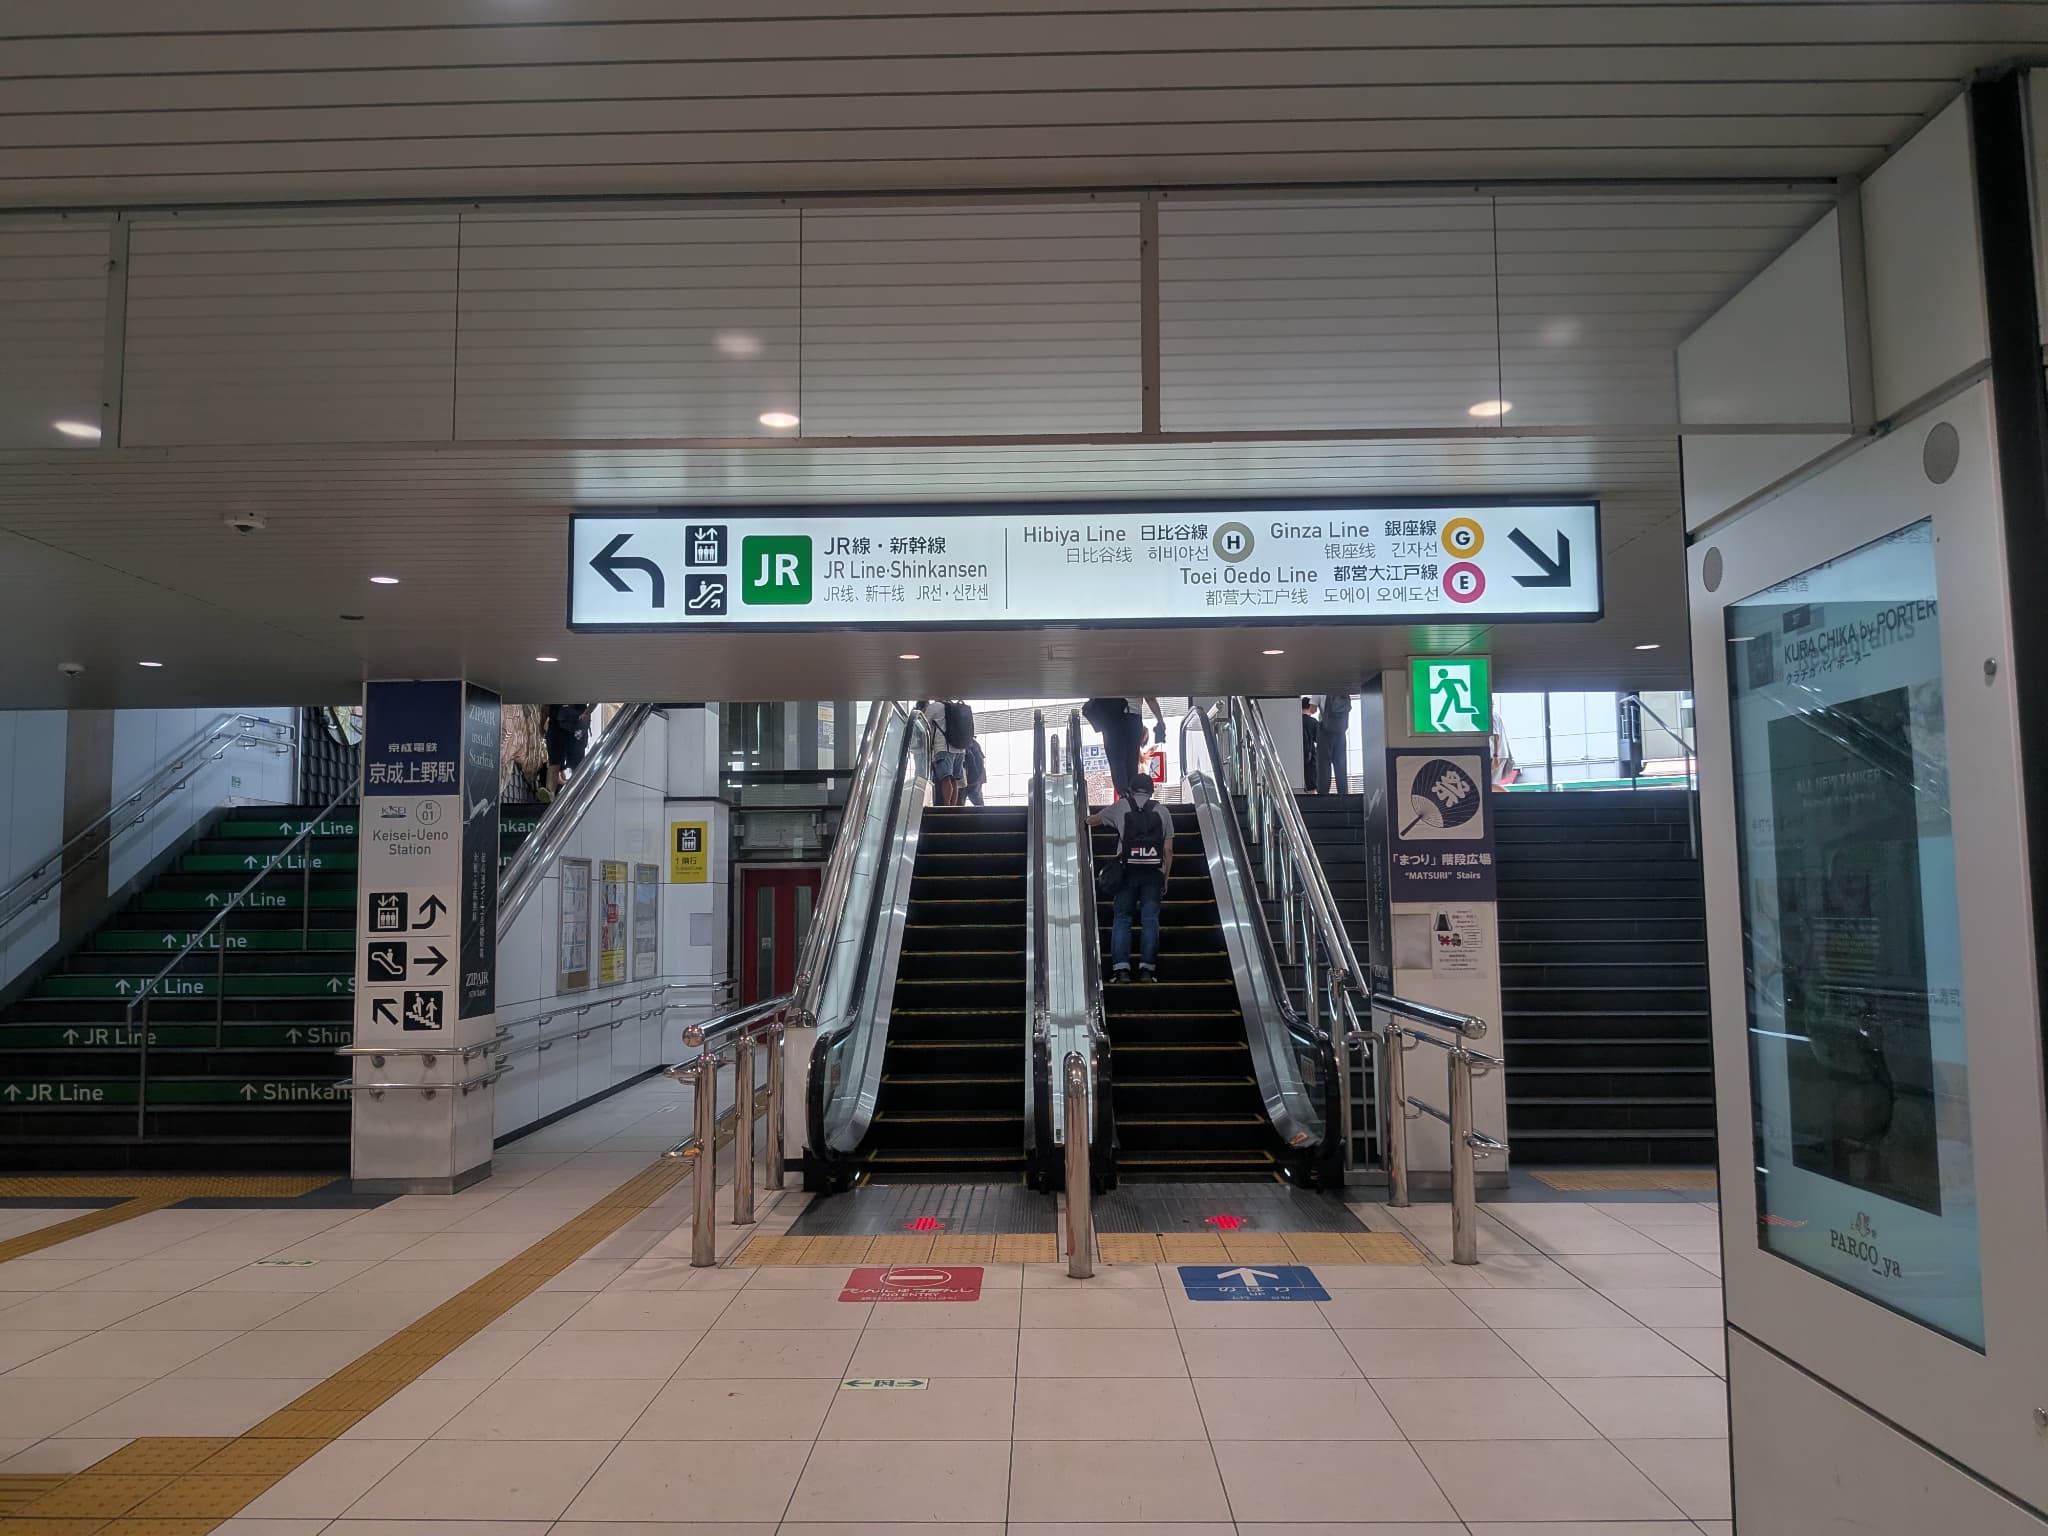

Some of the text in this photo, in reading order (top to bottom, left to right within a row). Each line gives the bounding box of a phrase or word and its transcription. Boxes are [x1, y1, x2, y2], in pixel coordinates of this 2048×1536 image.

[1024, 524, 1126, 546] Hibiya Line
[1140, 524, 1208, 541] 日比谷線
[1271, 521, 1369, 539] Ginza Line
[1384, 519, 1437, 537] 銀座線
[824, 535, 946, 555] JR線・新幹線
[1226, 535, 1240, 549] H
[1455, 530, 1470, 545] G
[1066, 547, 1132, 564] 日比谷线
[1147, 545, 1209, 562] 히비야선
[1324, 542, 1376, 559] 银座线
[1391, 541, 1438, 559] 긴자선
[754, 553, 800, 587] JR
[824, 560, 846, 579] JR
[1180, 565, 1318, 585] Toei Ōedo Line
[1334, 564, 1438, 582] 都営大江戸線
[1459, 575, 1469, 590] E
[1205, 588, 1308, 606] 都营大江户线
[1323, 585, 1439, 603] 도에이 오에도선
[1784, 600, 1937, 664] KURA CHIKA by PORTER
[469, 704, 496, 726] ZIPAIR
[388, 742, 438, 753] 京成電鉄
[369, 761, 456, 784] 京成上野駅
[422, 810, 434, 821] 01
[321, 821, 354, 835] Line
[372, 829, 449, 841] Keisei-Ueno
[388, 844, 432, 856] Station
[1130, 846, 1158, 857] FILA
[1441, 852, 1492, 866] 階段広場
[1456, 871, 1481, 880] Stairs
[224, 892, 286, 906] JR Line
[210, 933, 248, 948] Lne
[135, 978, 204, 994] JR Line
[466, 971, 489, 987] ZIPAIR
[84, 1028, 109, 1045] JR
[307, 1027, 352, 1044] Shin
[26, 1083, 104, 1101] JR Line
[263, 1082, 353, 1101] Shinkan
[1829, 1228, 1902, 1279] PARCO_ya
